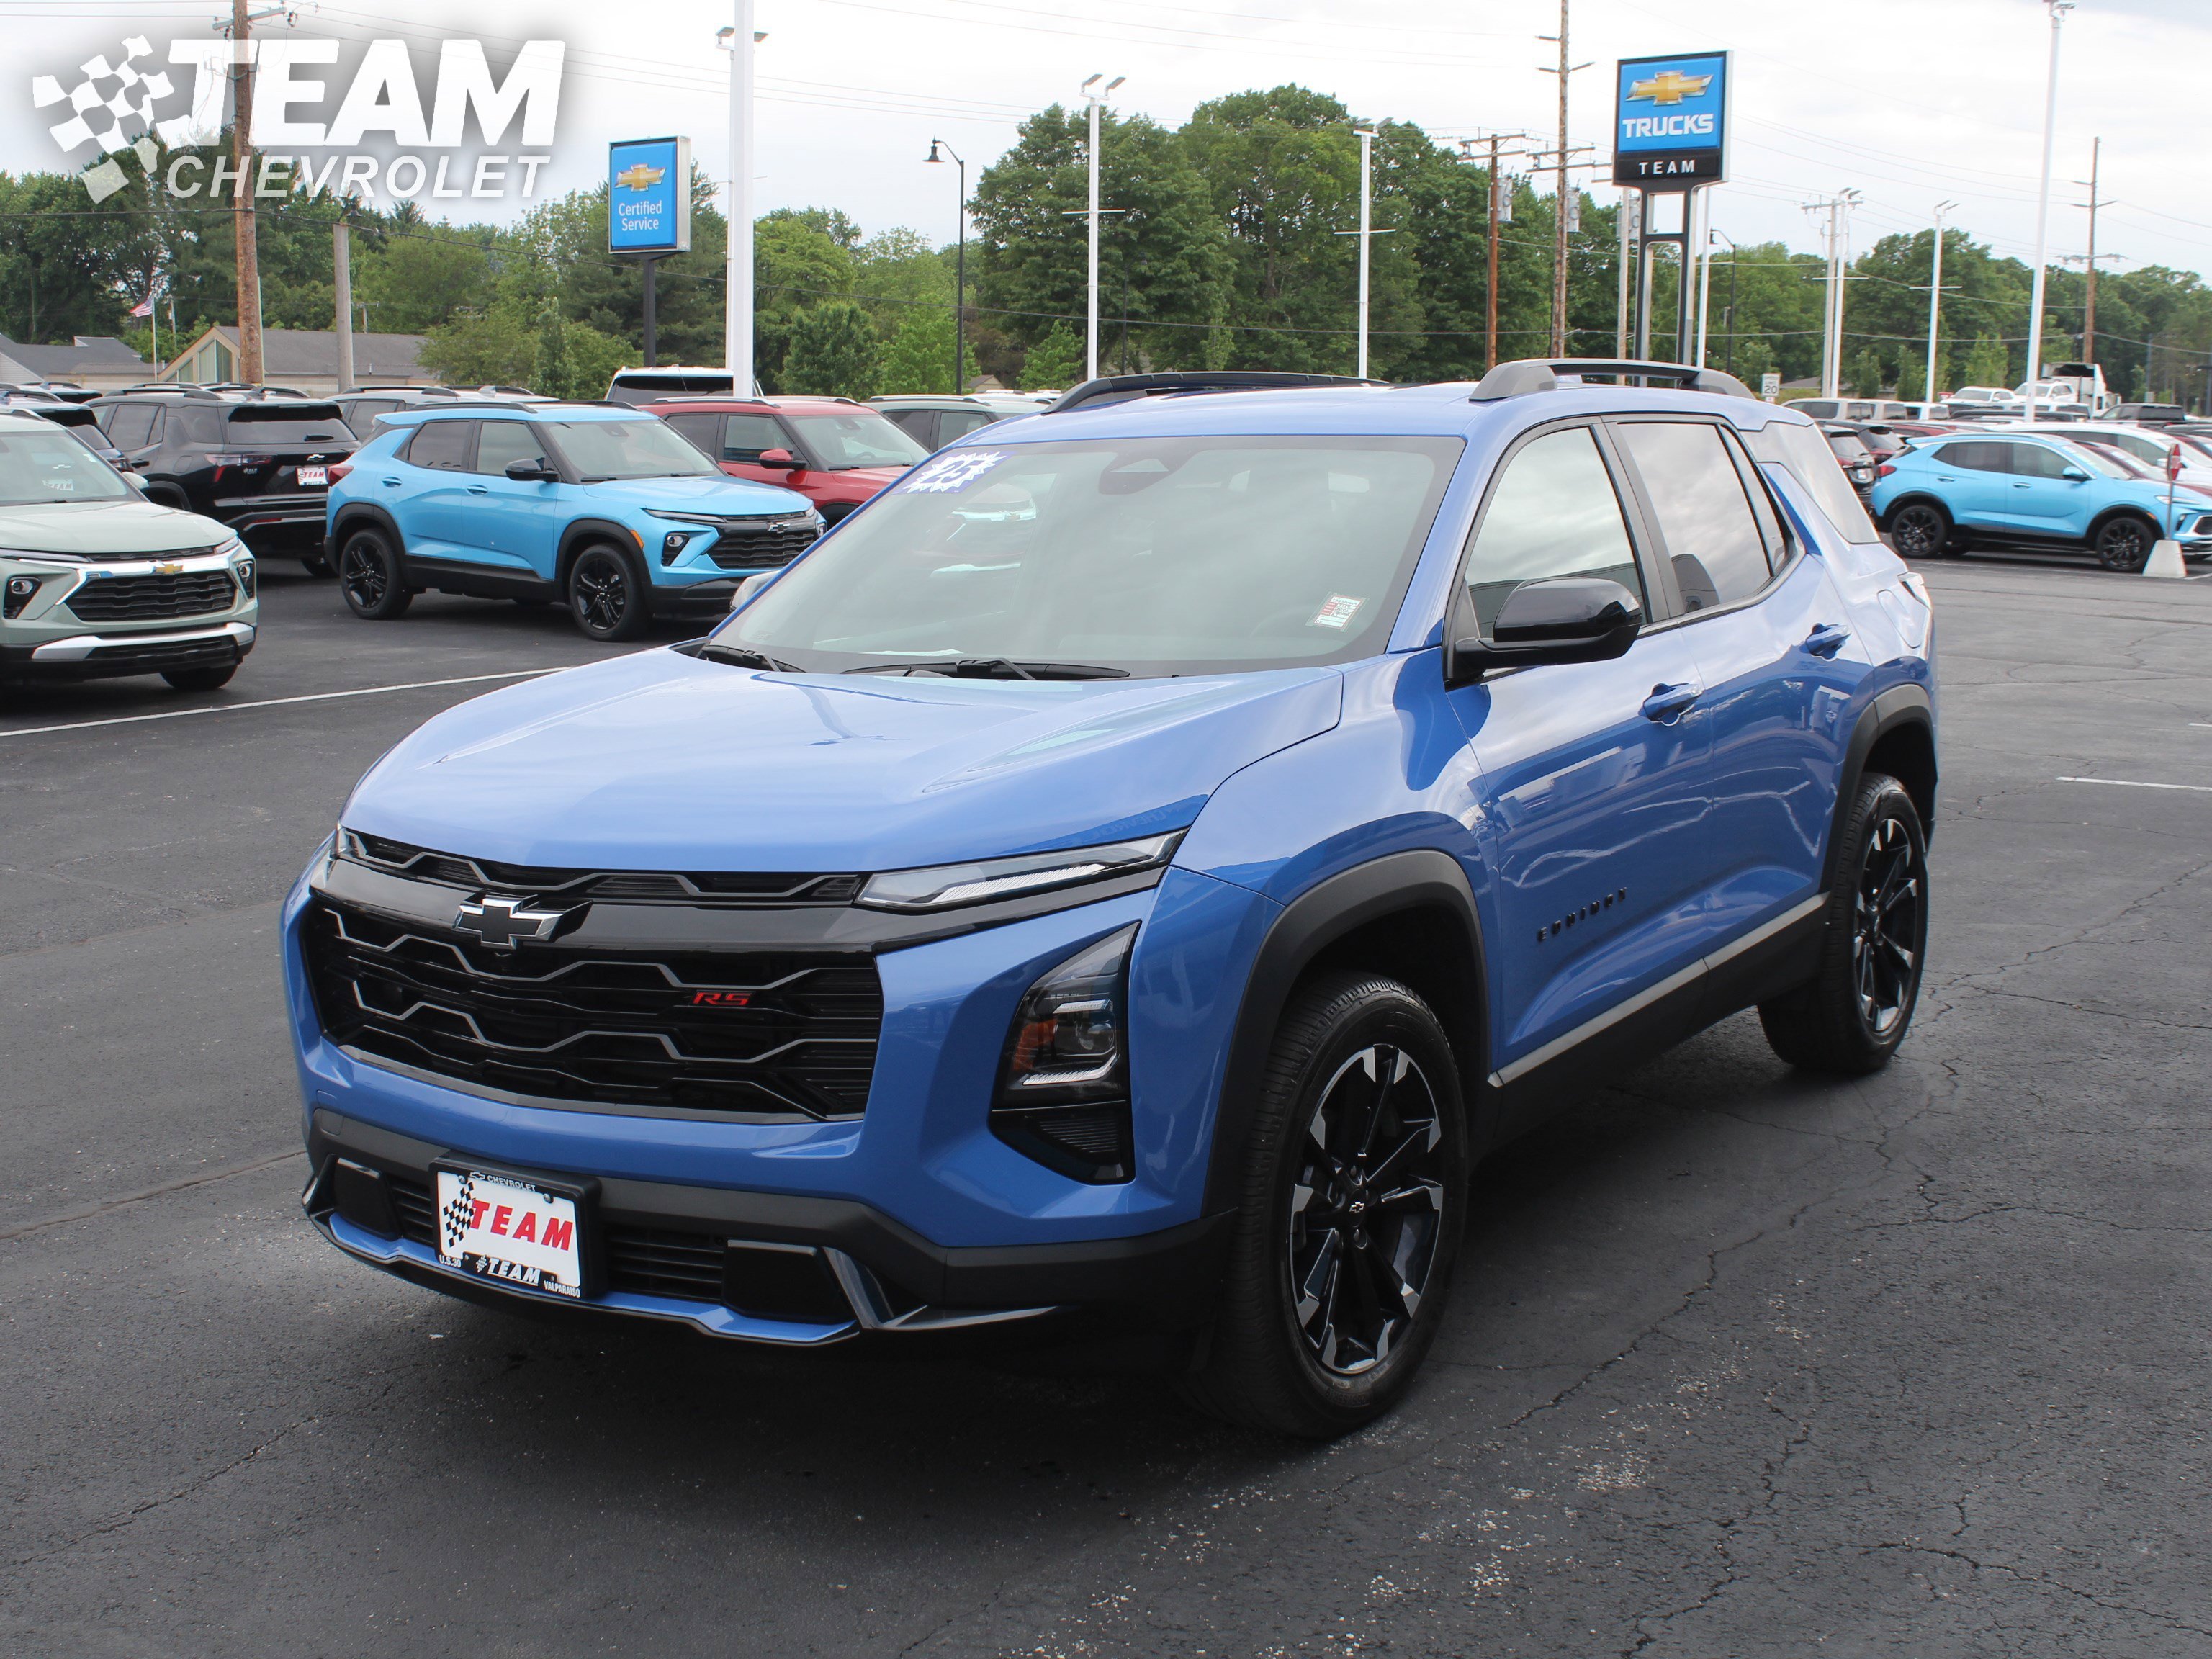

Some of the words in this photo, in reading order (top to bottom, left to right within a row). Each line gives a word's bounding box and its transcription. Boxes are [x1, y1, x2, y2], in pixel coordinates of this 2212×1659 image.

[1622, 114, 1714, 138] TRUCKS
[1638, 159, 1695, 175] TEAM
[618, 200, 662, 217] Certified
[621, 217, 659, 231] Service
[1764, 385, 1778, 394] 20
[693, 992, 752, 1006] RS
[487, 1175, 536, 1192] CHEVROLET
[469, 1200, 573, 1251] TEAM
[487, 1257, 542, 1285] TEAM
[544, 1280, 580, 1298] VALPARAISO
